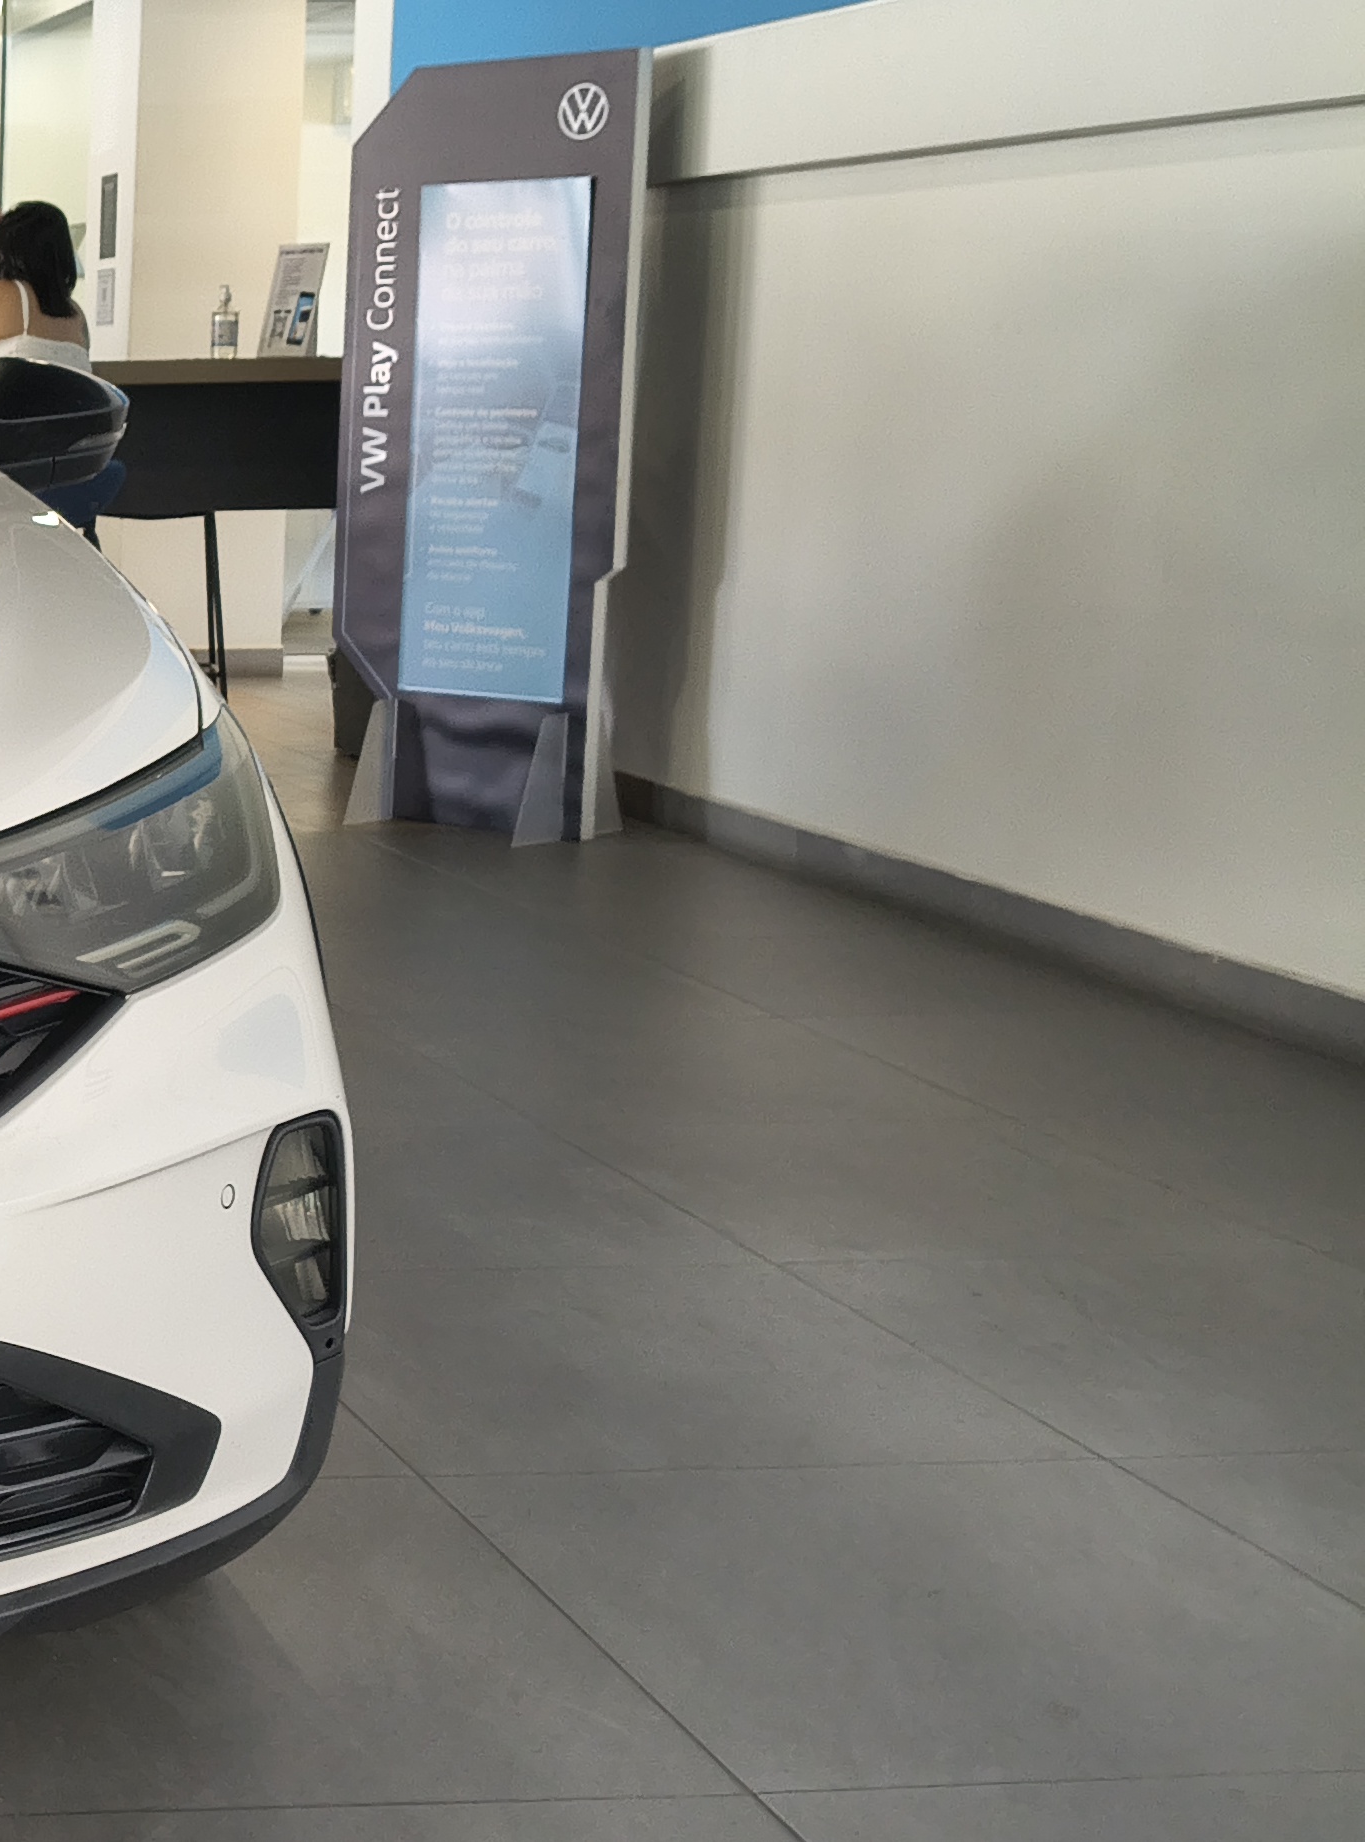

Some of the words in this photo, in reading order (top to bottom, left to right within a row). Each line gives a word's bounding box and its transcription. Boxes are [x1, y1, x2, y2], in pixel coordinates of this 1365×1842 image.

[366, 186, 401, 331] Connect
[363, 341, 399, 418] Play
[360, 427, 388, 494] VW
